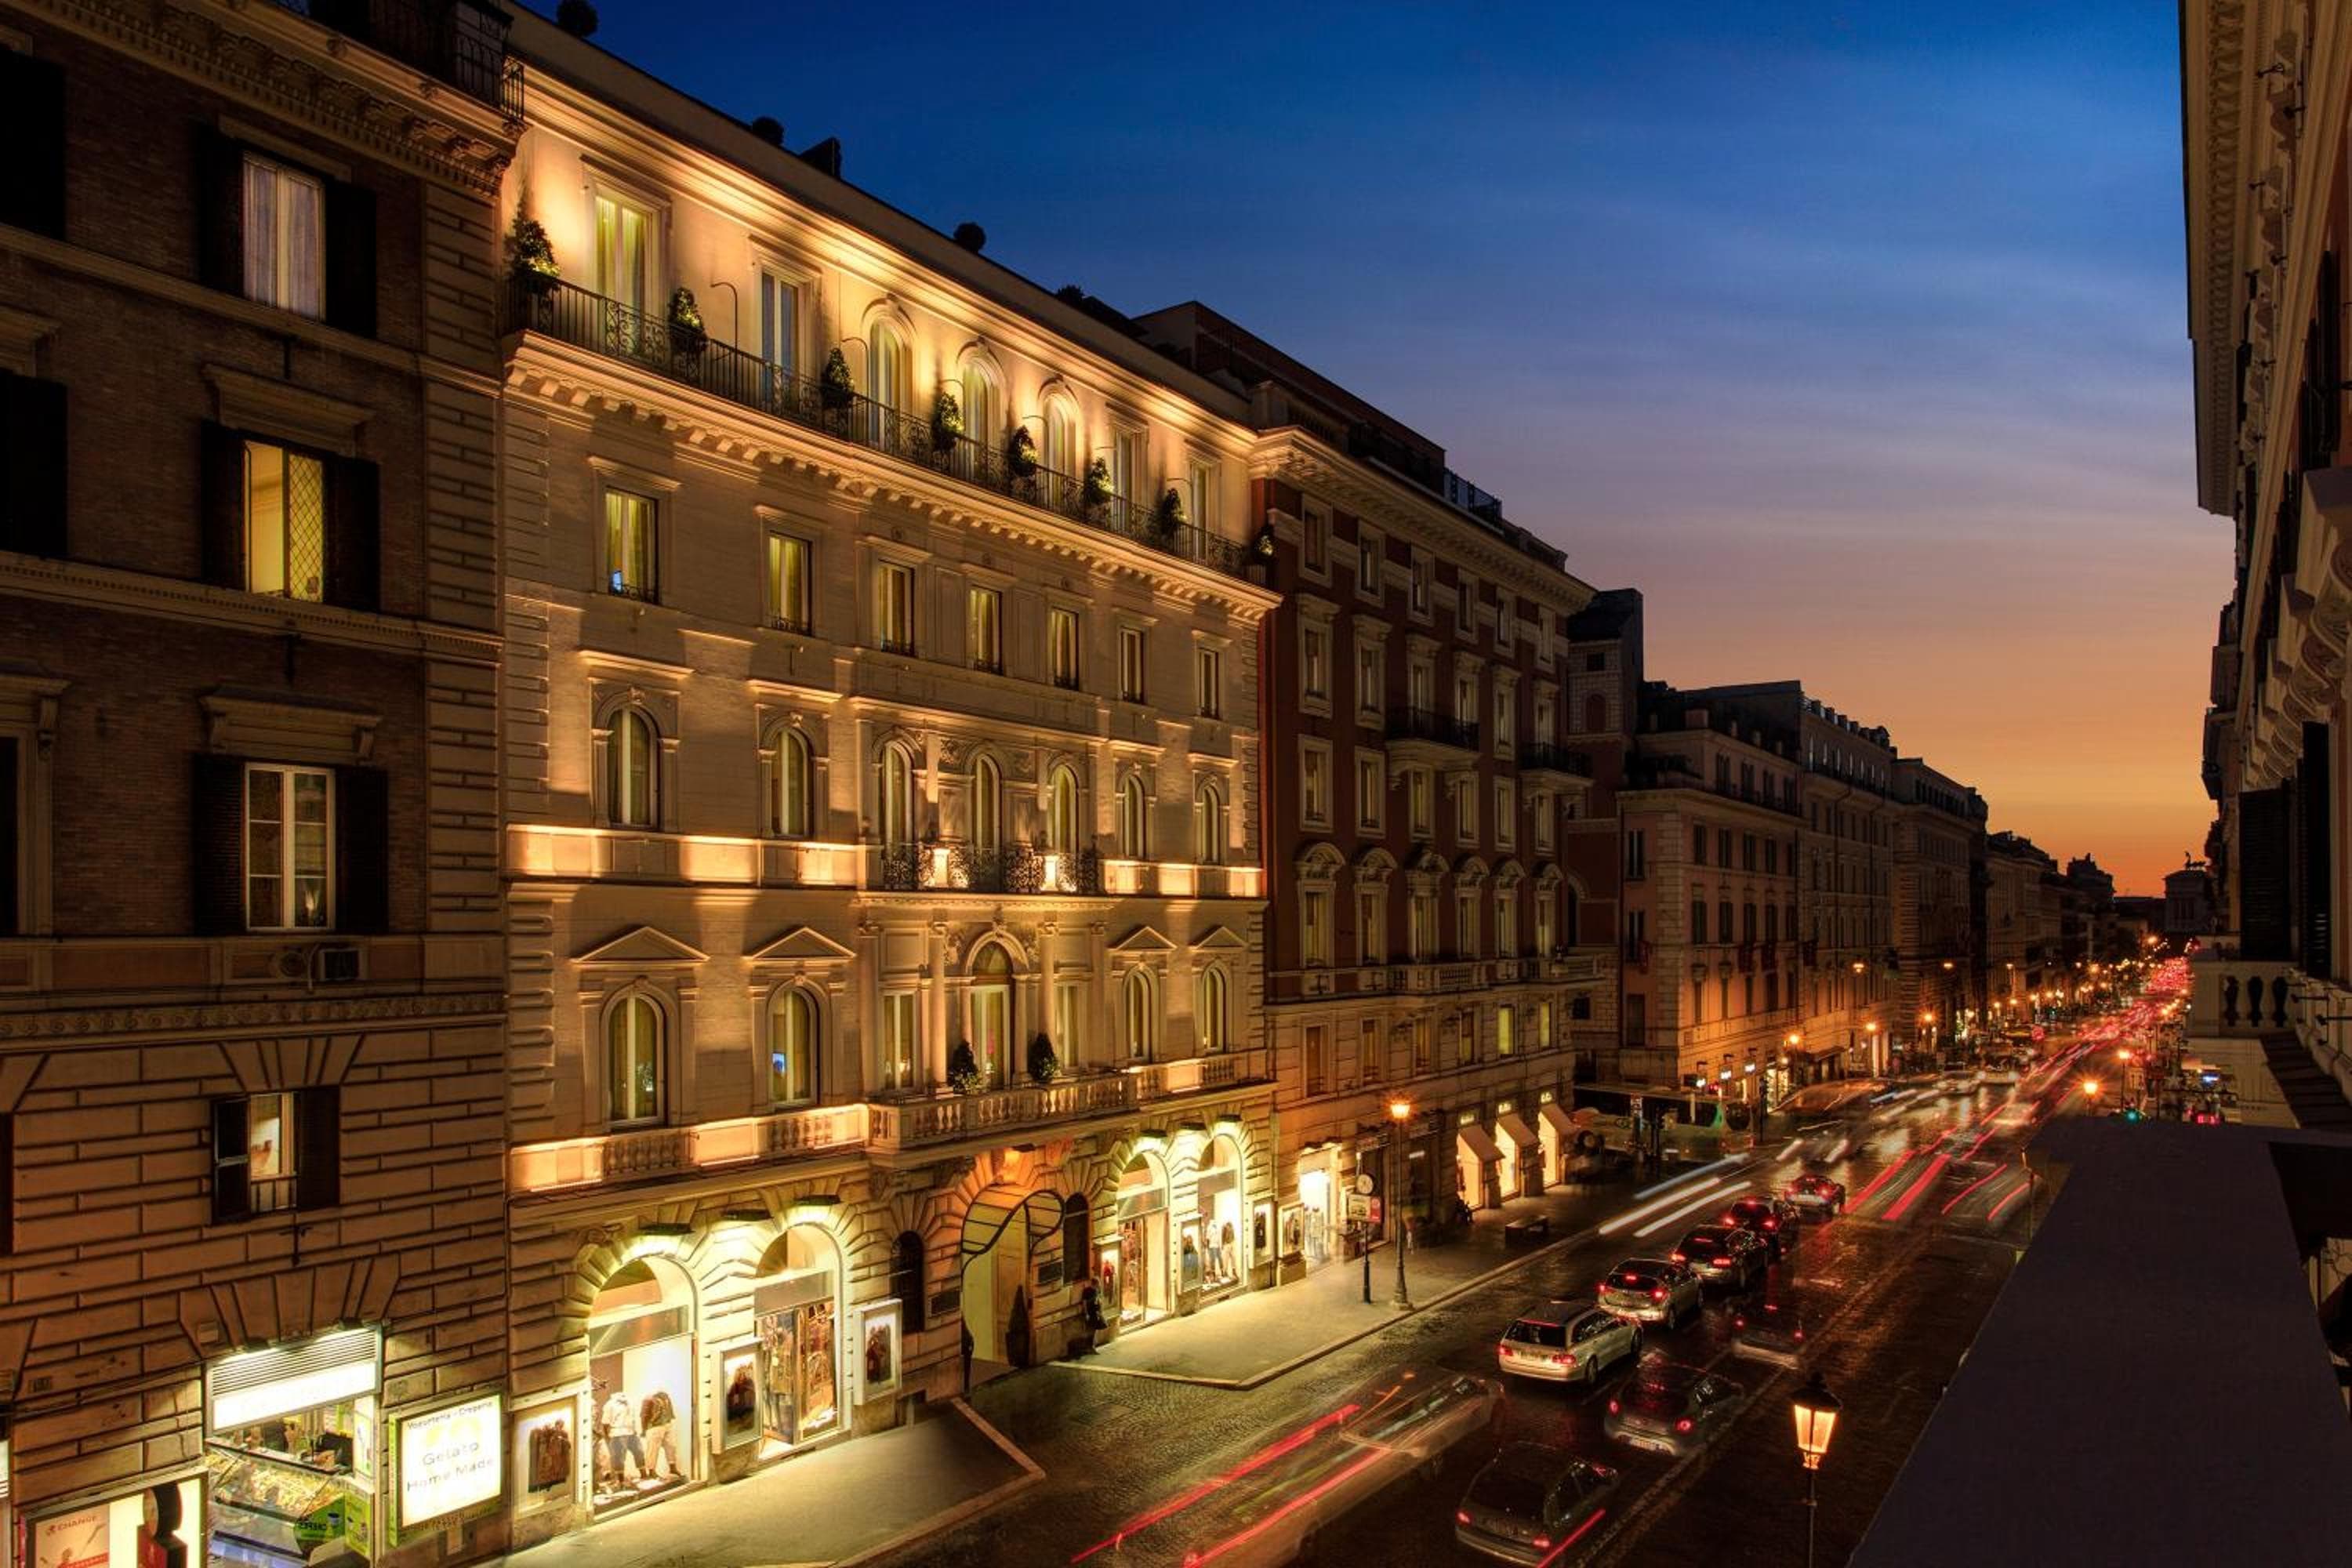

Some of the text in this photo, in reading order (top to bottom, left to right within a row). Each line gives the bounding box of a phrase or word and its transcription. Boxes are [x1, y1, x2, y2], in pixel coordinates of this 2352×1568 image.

[423, 1442, 480, 1465] Gelato
[407, 1457, 494, 1492] Home Made
